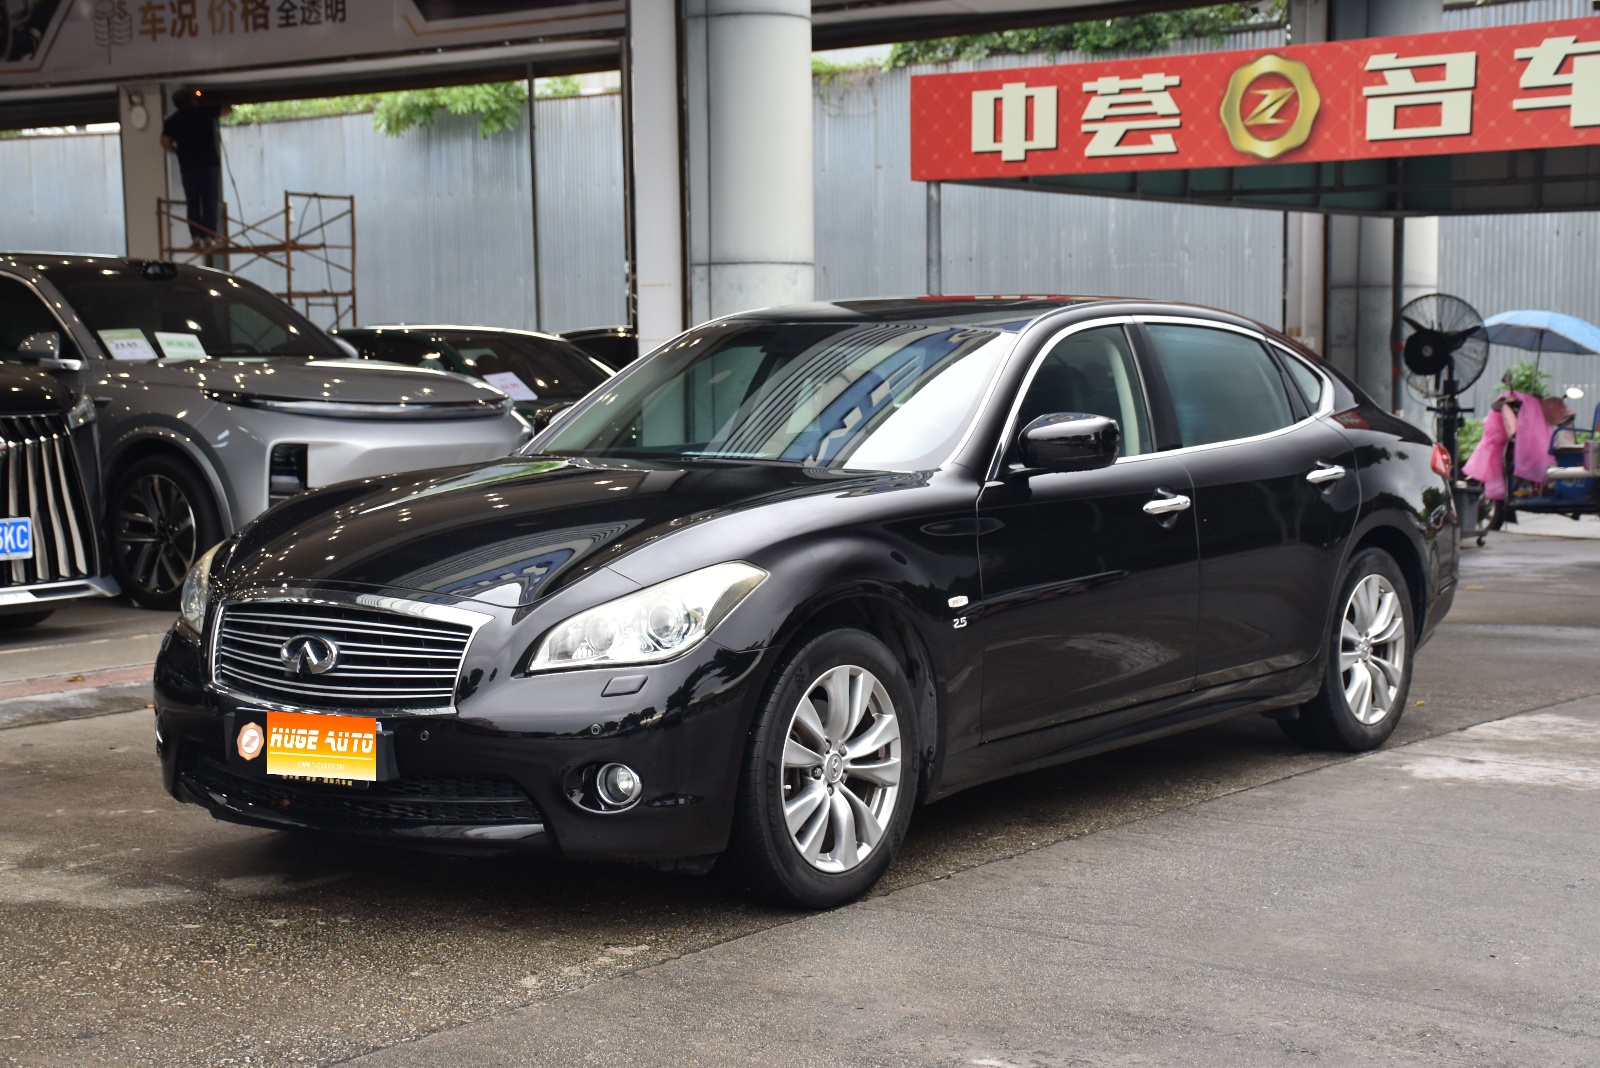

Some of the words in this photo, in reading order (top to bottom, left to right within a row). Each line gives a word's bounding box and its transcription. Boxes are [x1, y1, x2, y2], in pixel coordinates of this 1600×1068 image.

[138, 2, 199, 42] 车况
[208, 0, 270, 36] 价格
[276, 0, 346, 29] 全透明
[971, 72, 1181, 162] 中荟
[1362, 35, 1600, 142] 名车
